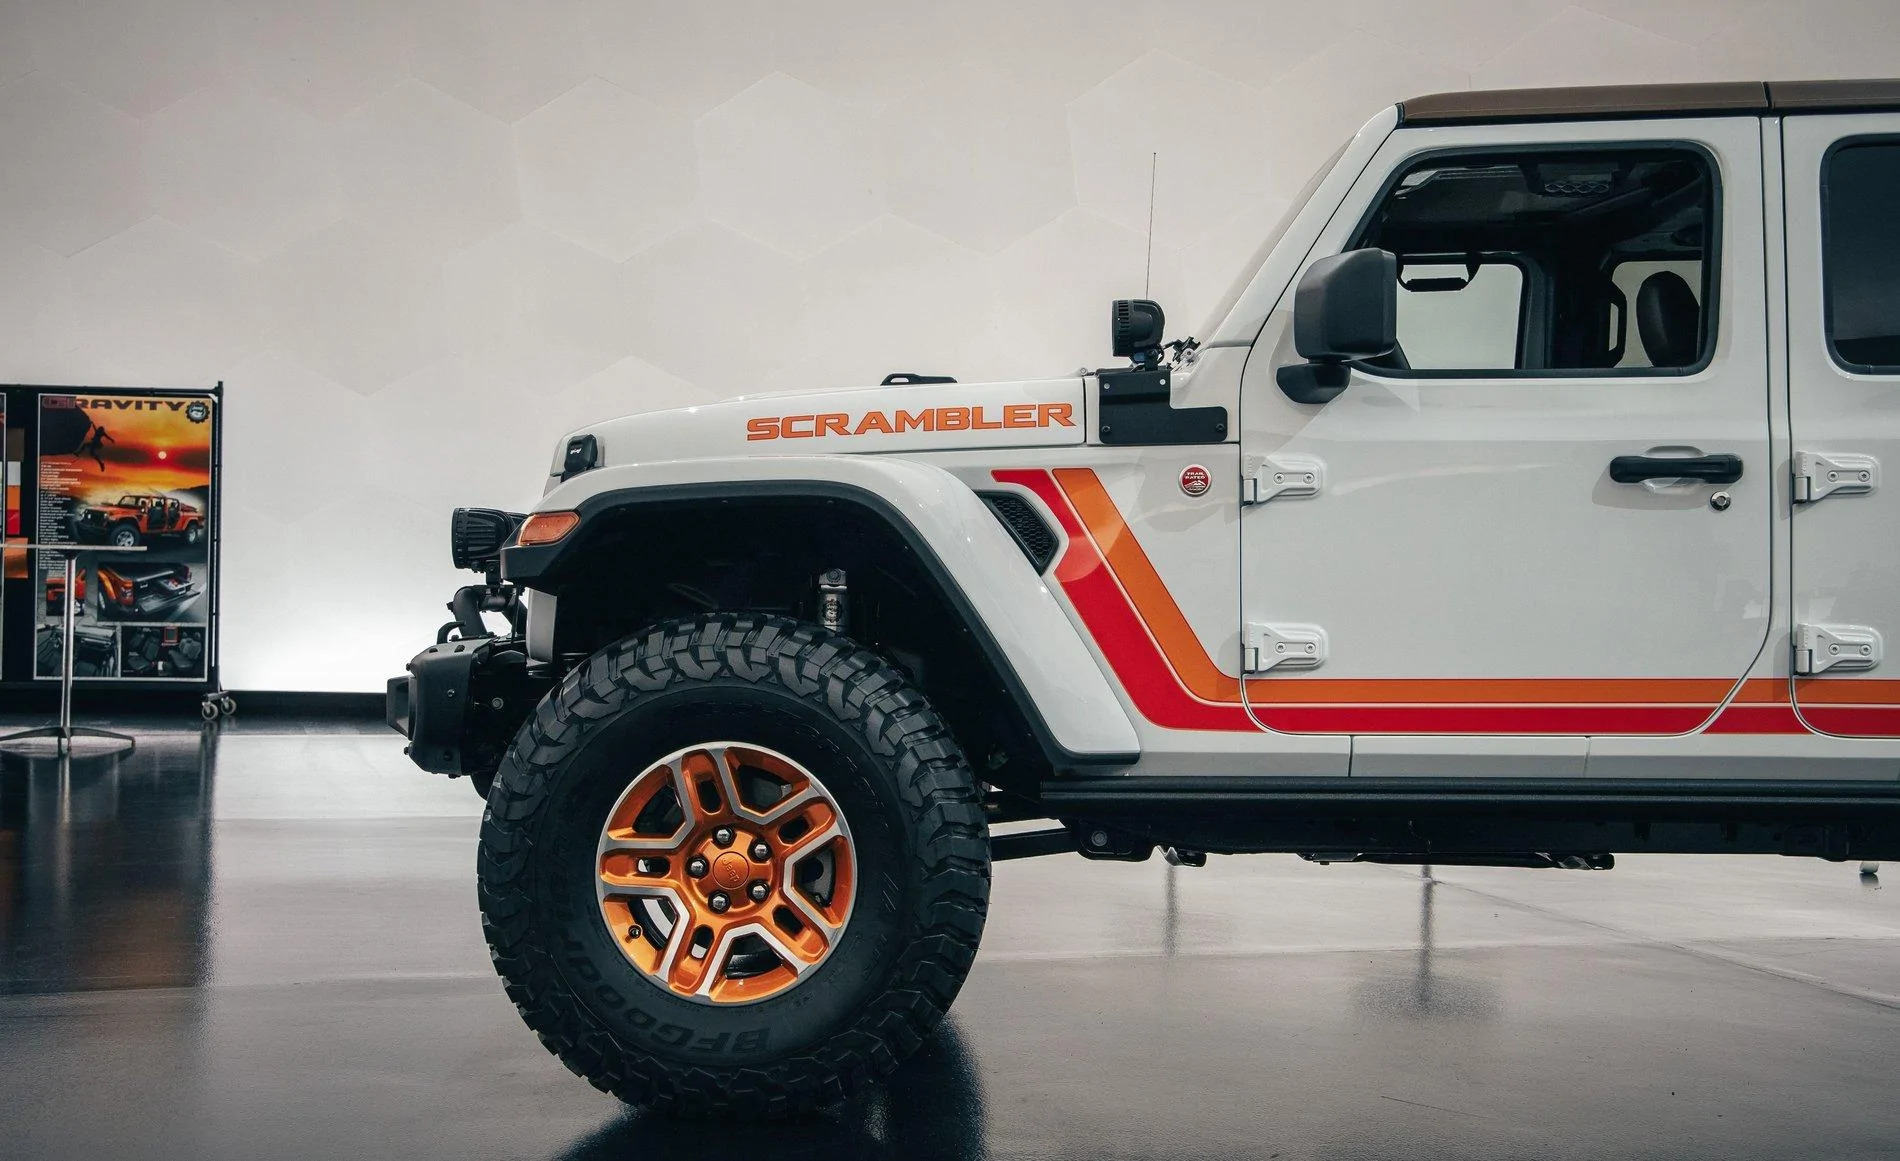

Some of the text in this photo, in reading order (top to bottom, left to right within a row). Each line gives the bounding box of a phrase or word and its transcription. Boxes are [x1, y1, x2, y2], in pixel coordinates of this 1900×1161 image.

[42, 396, 186, 411] GRAVITY
[746, 403, 1077, 441] SCRAMBLER
[722, 858, 740, 882] Jeep
